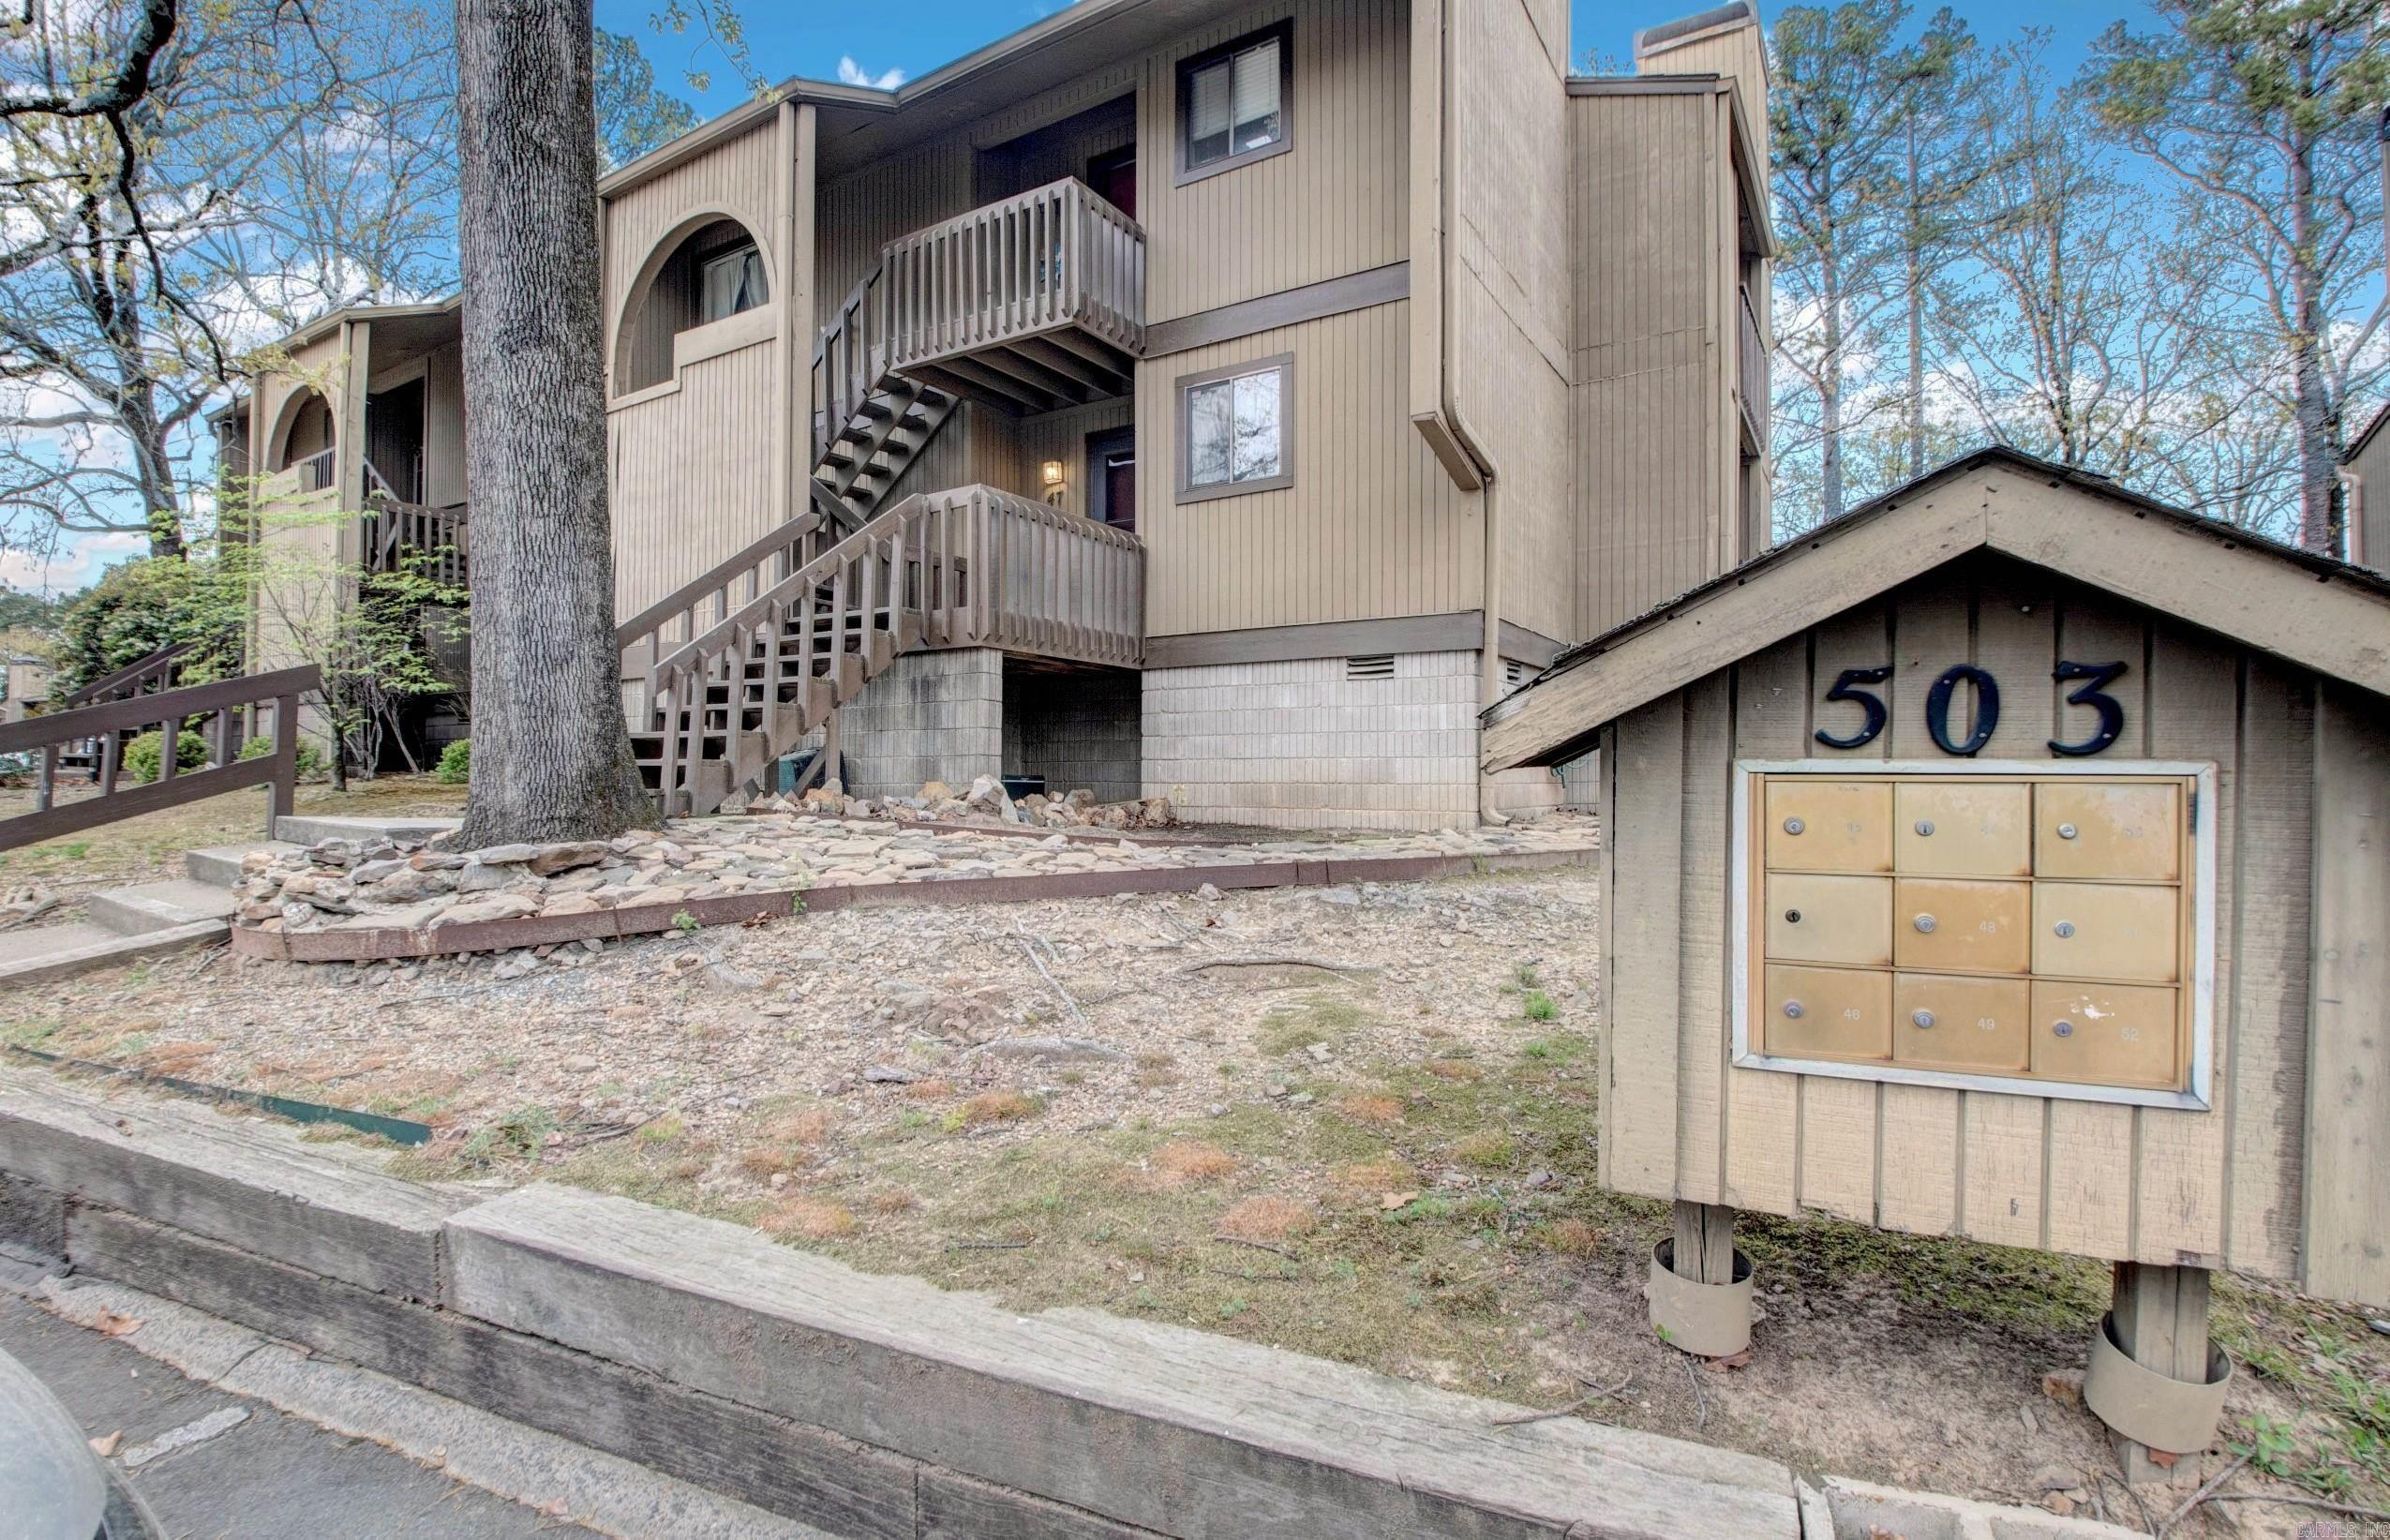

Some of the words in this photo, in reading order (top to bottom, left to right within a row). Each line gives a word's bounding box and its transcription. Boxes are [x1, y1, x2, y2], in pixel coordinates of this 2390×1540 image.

[1814, 660, 2129, 756] 503
[1979, 921, 1995, 934] 48
[1844, 1007, 1860, 1021] 46
[1978, 1017, 1995, 1029] 49
[2121, 1027, 2139, 1041] 52
